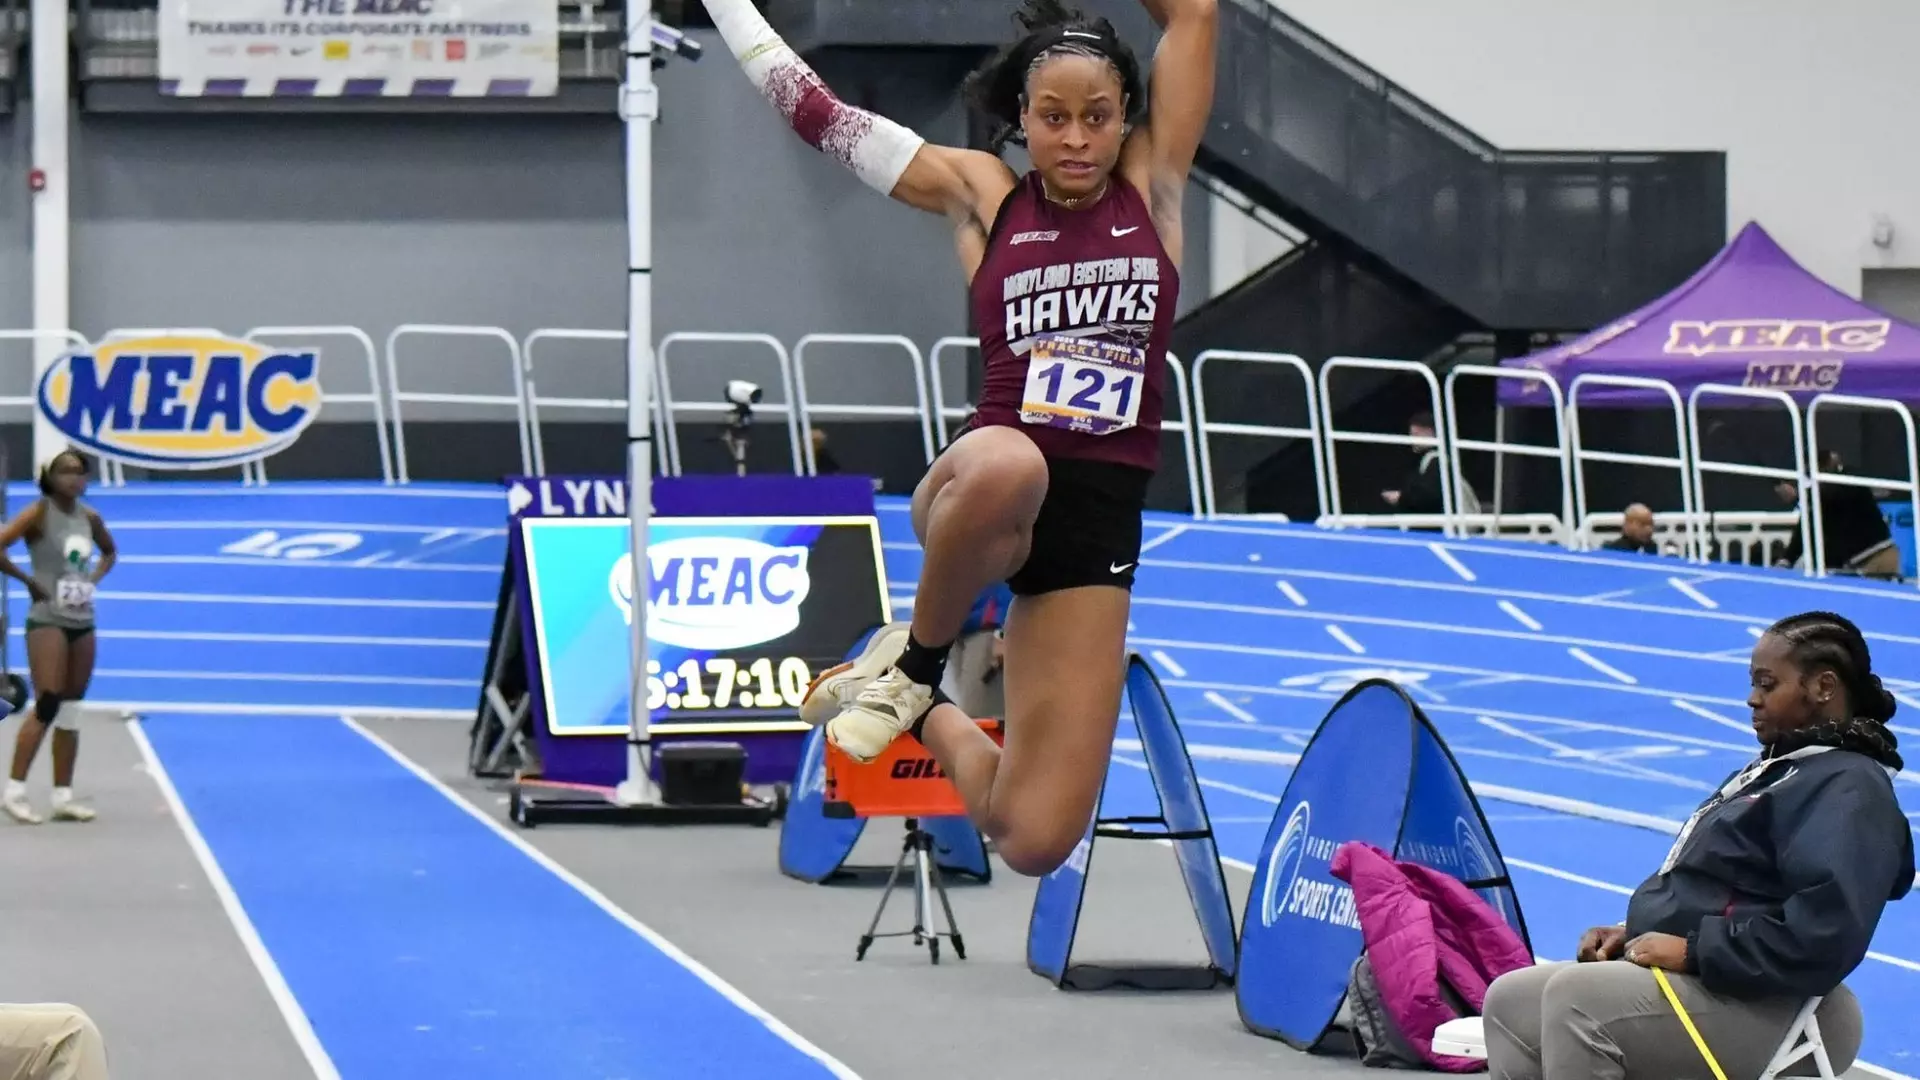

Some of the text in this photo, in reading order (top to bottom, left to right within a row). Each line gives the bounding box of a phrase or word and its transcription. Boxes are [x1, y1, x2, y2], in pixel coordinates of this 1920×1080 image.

[188, 21, 532, 36] THANKS ITS CORPORATE PARTNERS
[1004, 262, 1071, 302] MARYLAND
[1072, 256, 1130, 287] EASTERN
[1006, 283, 1160, 341] HAWKS
[1037, 339, 1087, 355] TRACK
[1105, 350, 1141, 367] FIELD
[1101, 341, 1132, 354] INDOOR
[1665, 319, 1890, 356] MEAC
[68, 353, 317, 433] MEAC
[1037, 362, 1134, 418] 121
[1747, 362, 1840, 388] MEAC
[540, 480, 656, 515] LYN
[646, 555, 801, 607] MEAC
[1307, 836, 1341, 861] VIRGI
[1289, 876, 1335, 921] SPORTS
